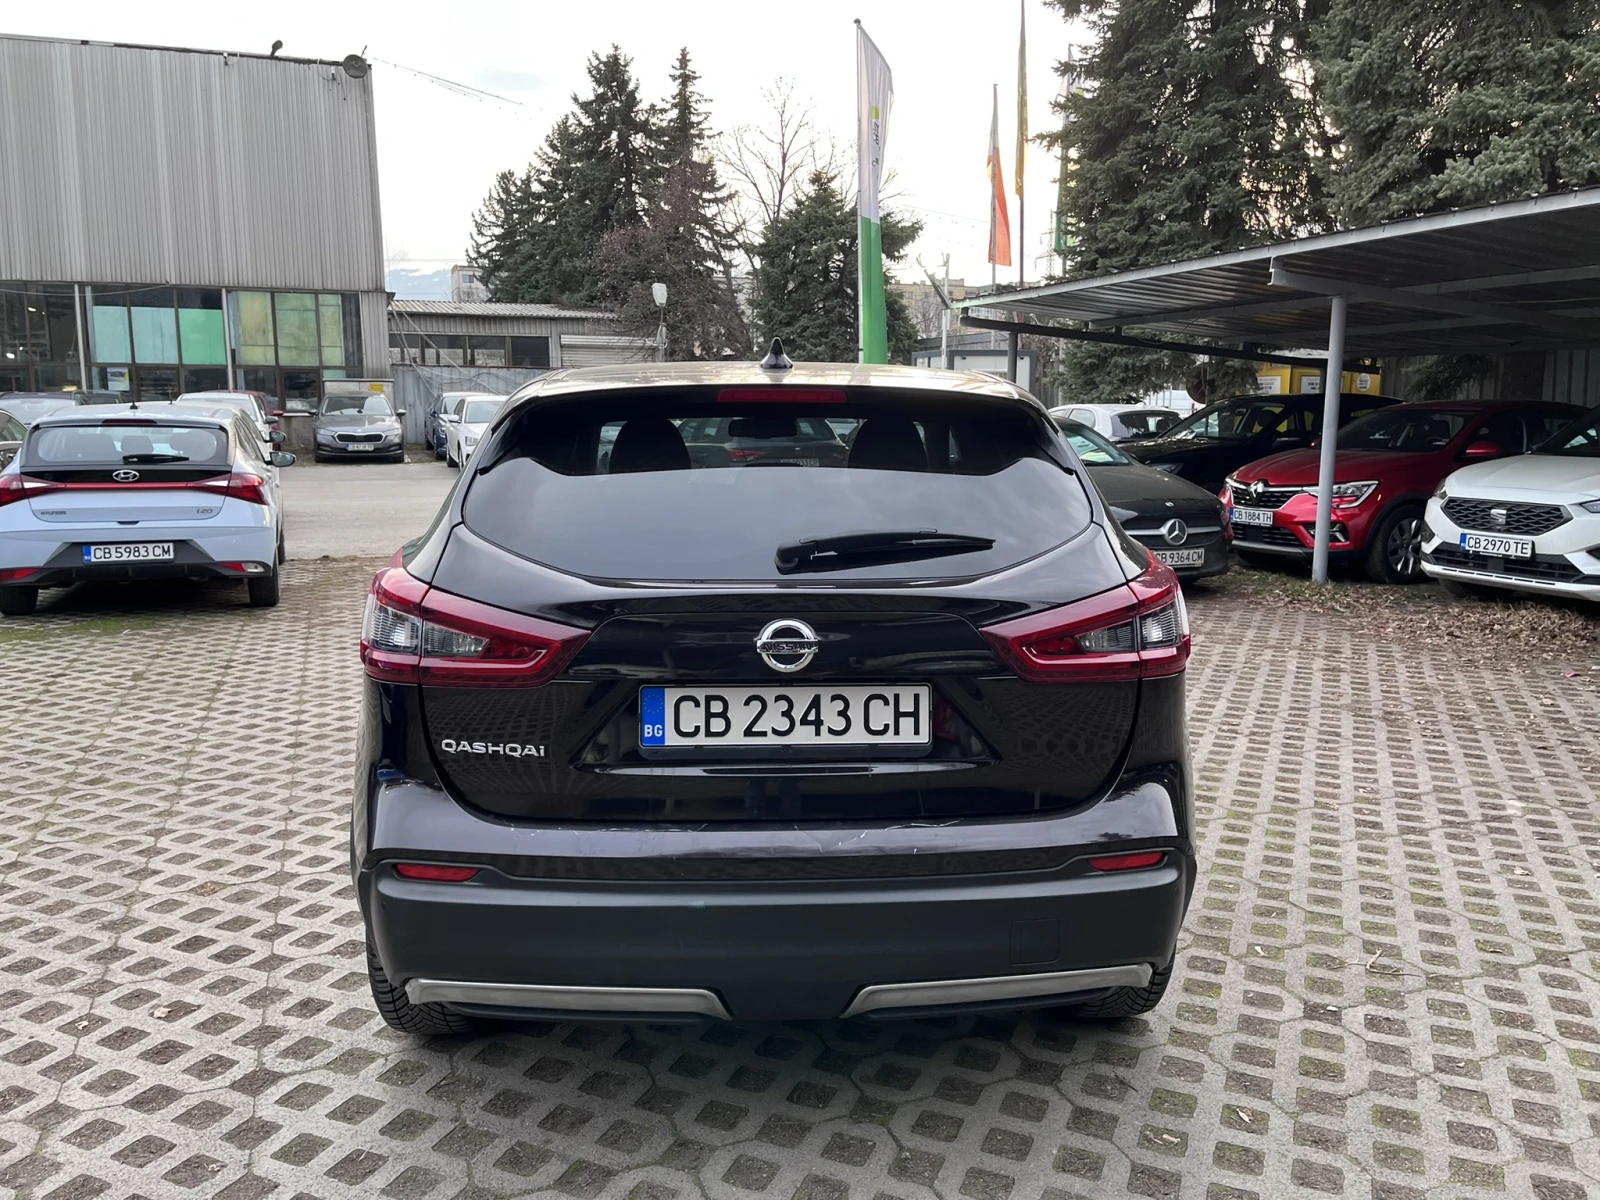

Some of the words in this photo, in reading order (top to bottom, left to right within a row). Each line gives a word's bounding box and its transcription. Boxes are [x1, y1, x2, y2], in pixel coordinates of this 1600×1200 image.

[1234, 510, 1243, 520] CB
[1244, 511, 1260, 521] 1884
[1262, 512, 1272, 523] TH
[93, 547, 112, 560] CB
[114, 546, 150, 559] 5983
[152, 545, 171, 558] CM
[1467, 537, 1480, 549] CB
[1483, 538, 1511, 553] 2970
[1513, 541, 1529, 555] TE
[1169, 552, 1190, 563] 9364
[1191, 551, 1203, 562] CM
[763, 642, 815, 652] NISSAN
[673, 694, 732, 738] CB
[743, 693, 852, 737] 2343
[863, 693, 920, 737] CH
[644, 724, 663, 738] BG
